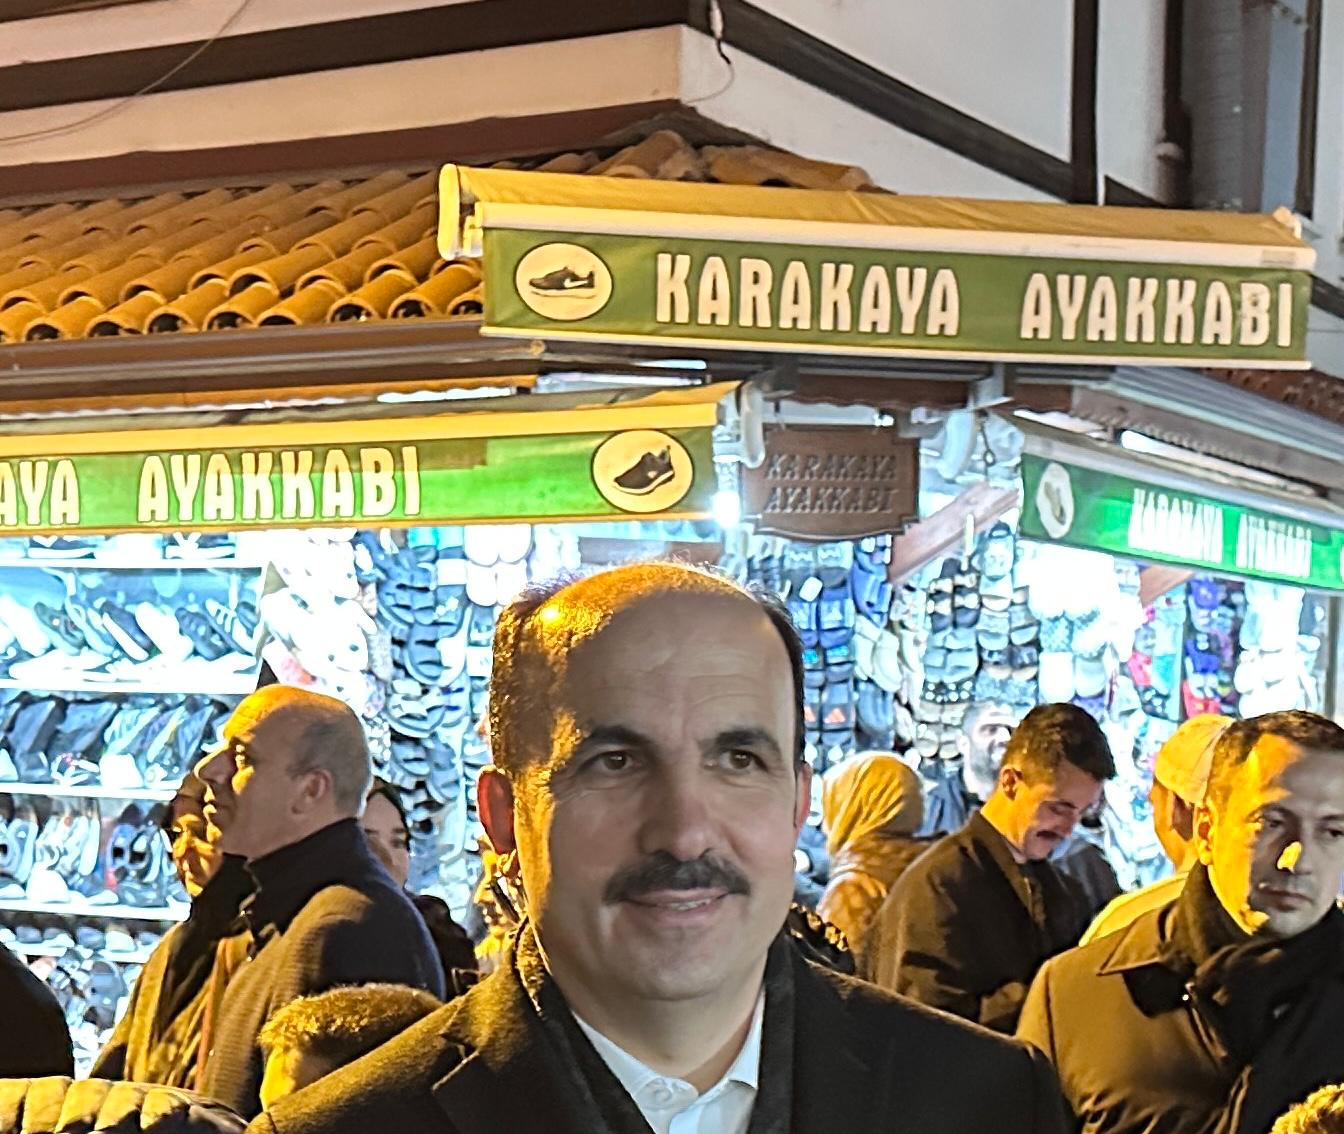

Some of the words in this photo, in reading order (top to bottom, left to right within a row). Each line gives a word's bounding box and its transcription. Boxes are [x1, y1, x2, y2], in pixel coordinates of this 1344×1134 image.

[656, 253, 960, 336] KARAKAYA
[1021, 274, 1292, 347] AYAKKABI
[137, 446, 422, 523] AYAKKABI
[766, 453, 898, 482] KARAKAYA
[765, 486, 899, 515] AYAKKABI
